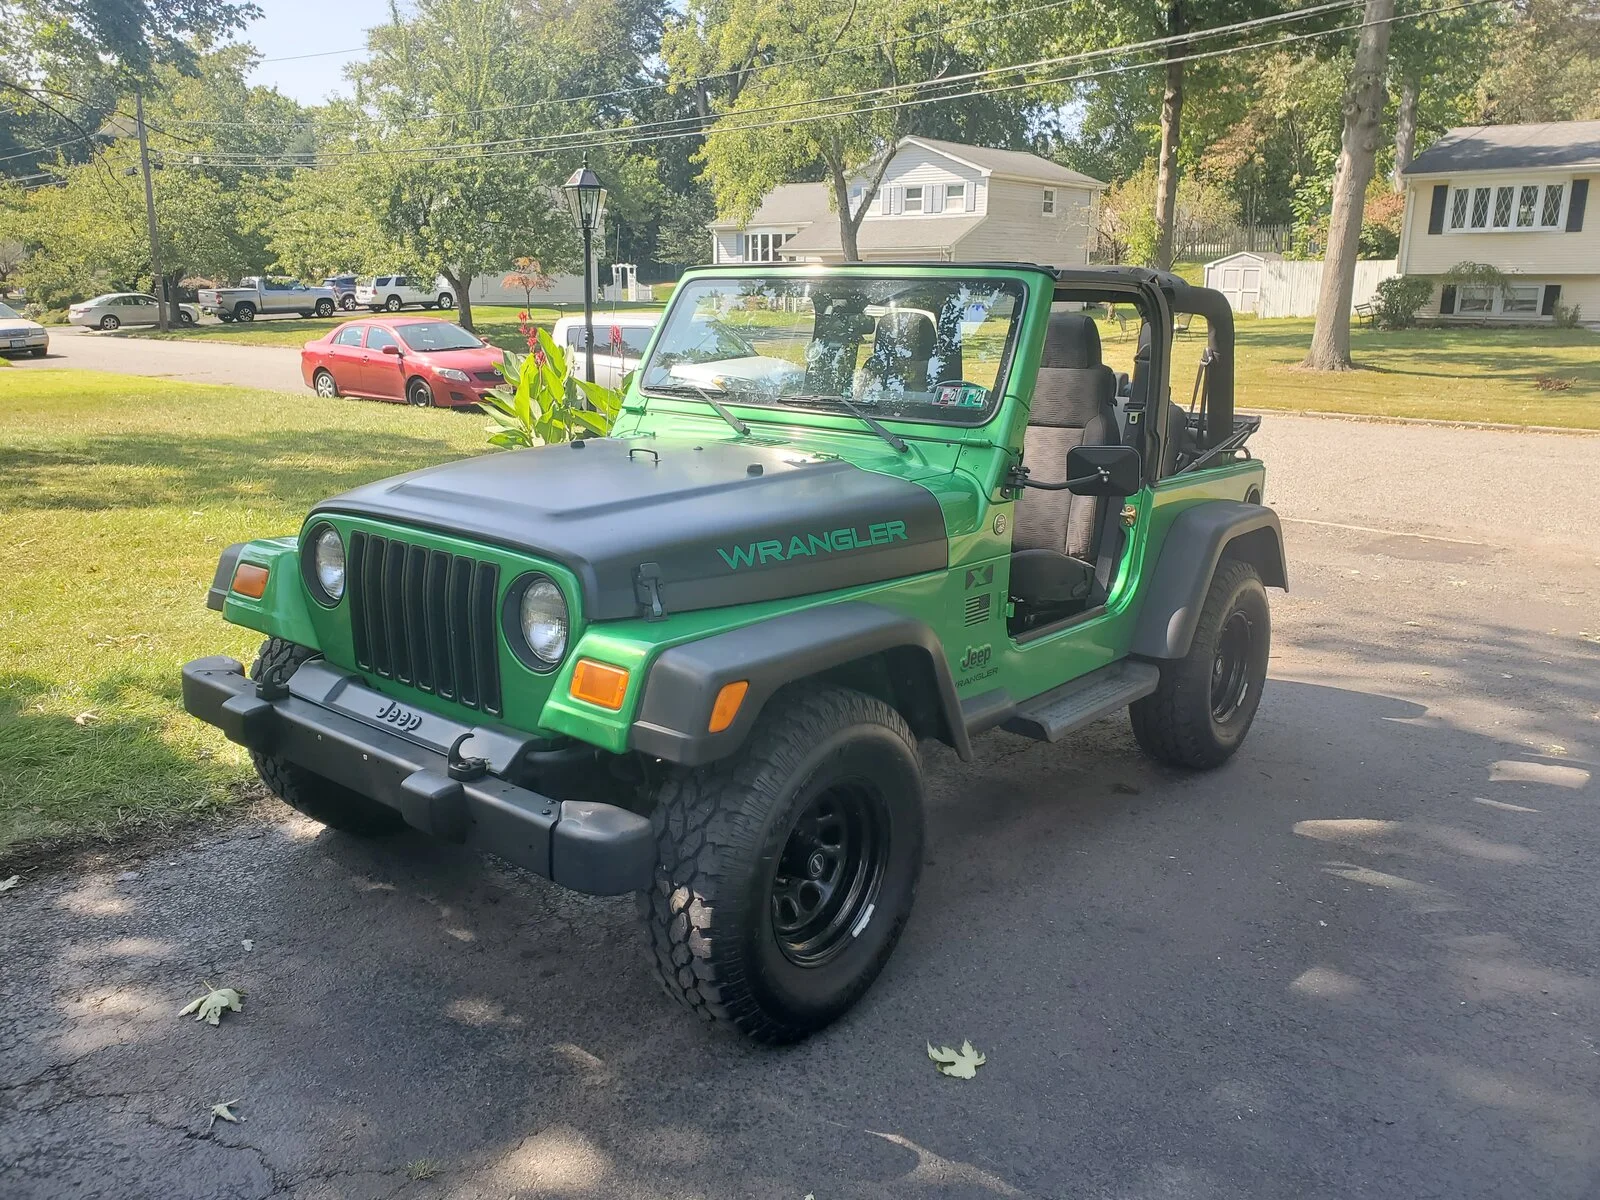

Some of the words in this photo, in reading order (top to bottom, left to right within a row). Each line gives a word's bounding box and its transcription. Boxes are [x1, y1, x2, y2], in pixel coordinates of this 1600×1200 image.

[716, 520, 909, 570] WRANGLER
[961, 645, 992, 670] Jeep
[375, 701, 423, 732] Jeep
